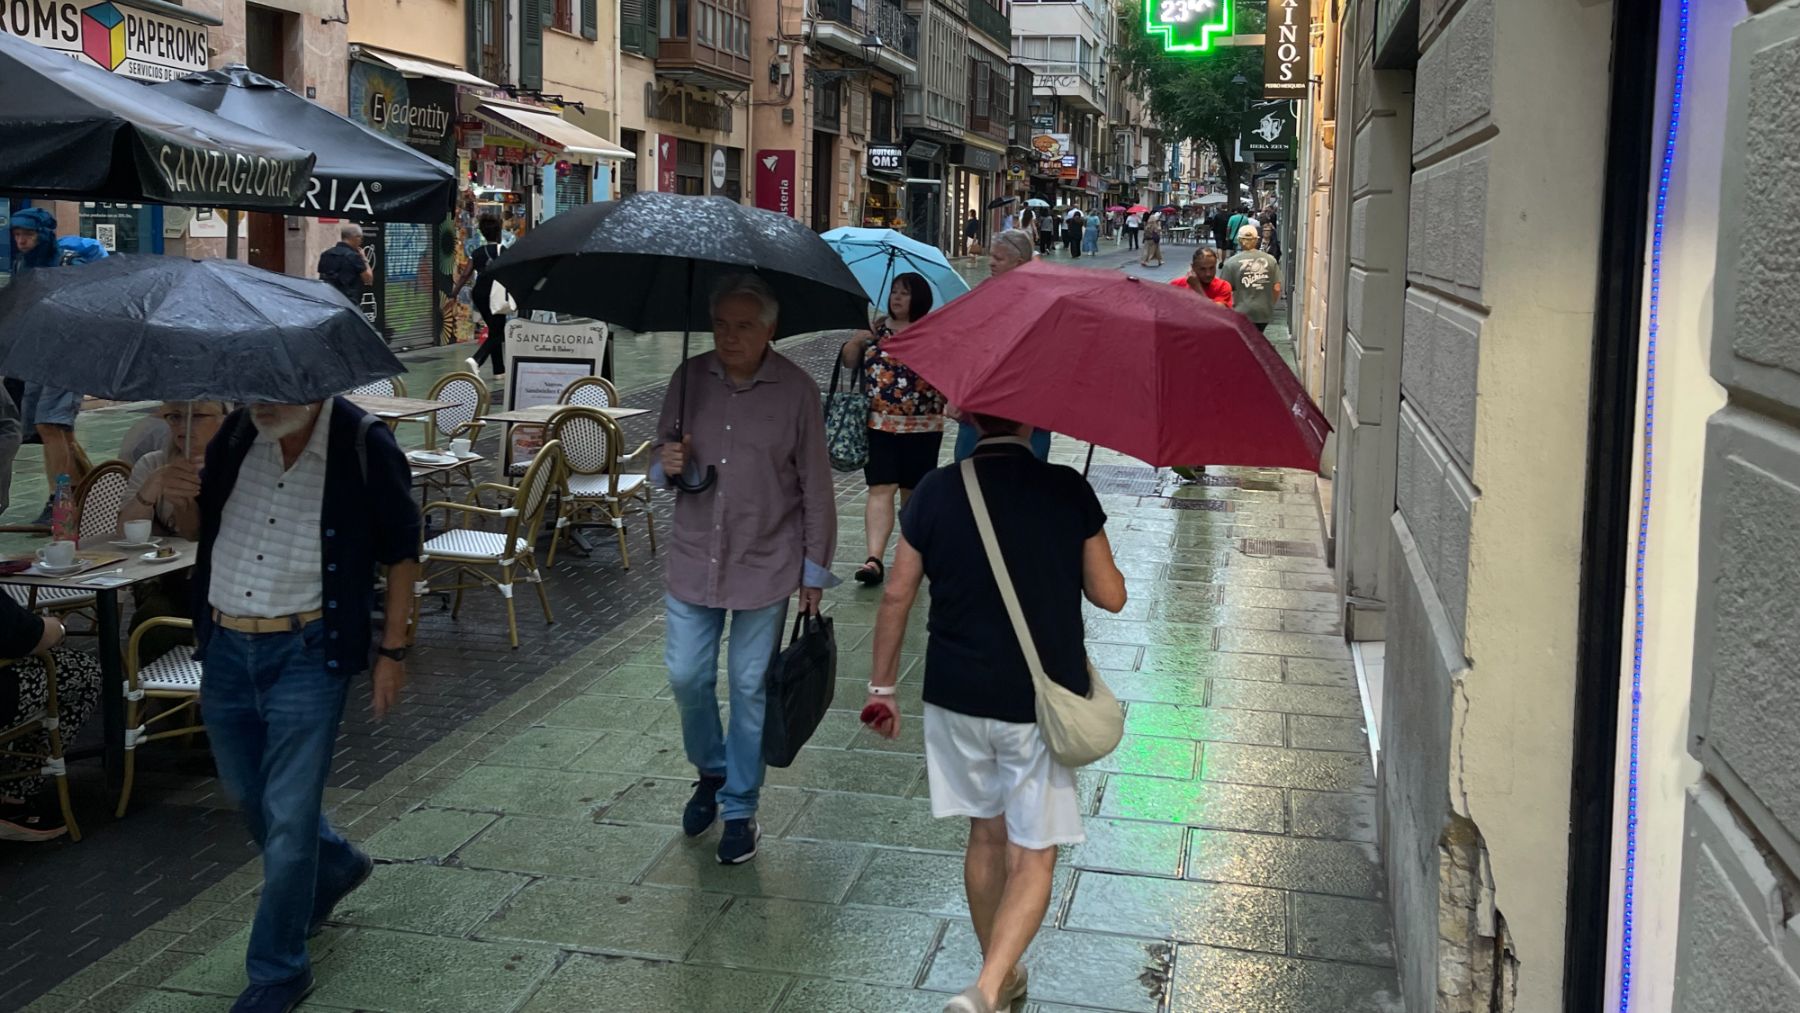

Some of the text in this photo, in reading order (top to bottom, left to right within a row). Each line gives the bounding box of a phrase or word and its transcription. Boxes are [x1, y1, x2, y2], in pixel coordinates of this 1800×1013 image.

[127, 14, 206, 66] PAPEROMS
[129, 62, 163, 79] SERVICIOS
[164, 70, 172, 80] DE
[373, 93, 449, 137] Eyedentity
[872, 156, 898, 167] OMS
[779, 179, 789, 215] steria
[516, 333, 594, 345] SANTAGLORIA
